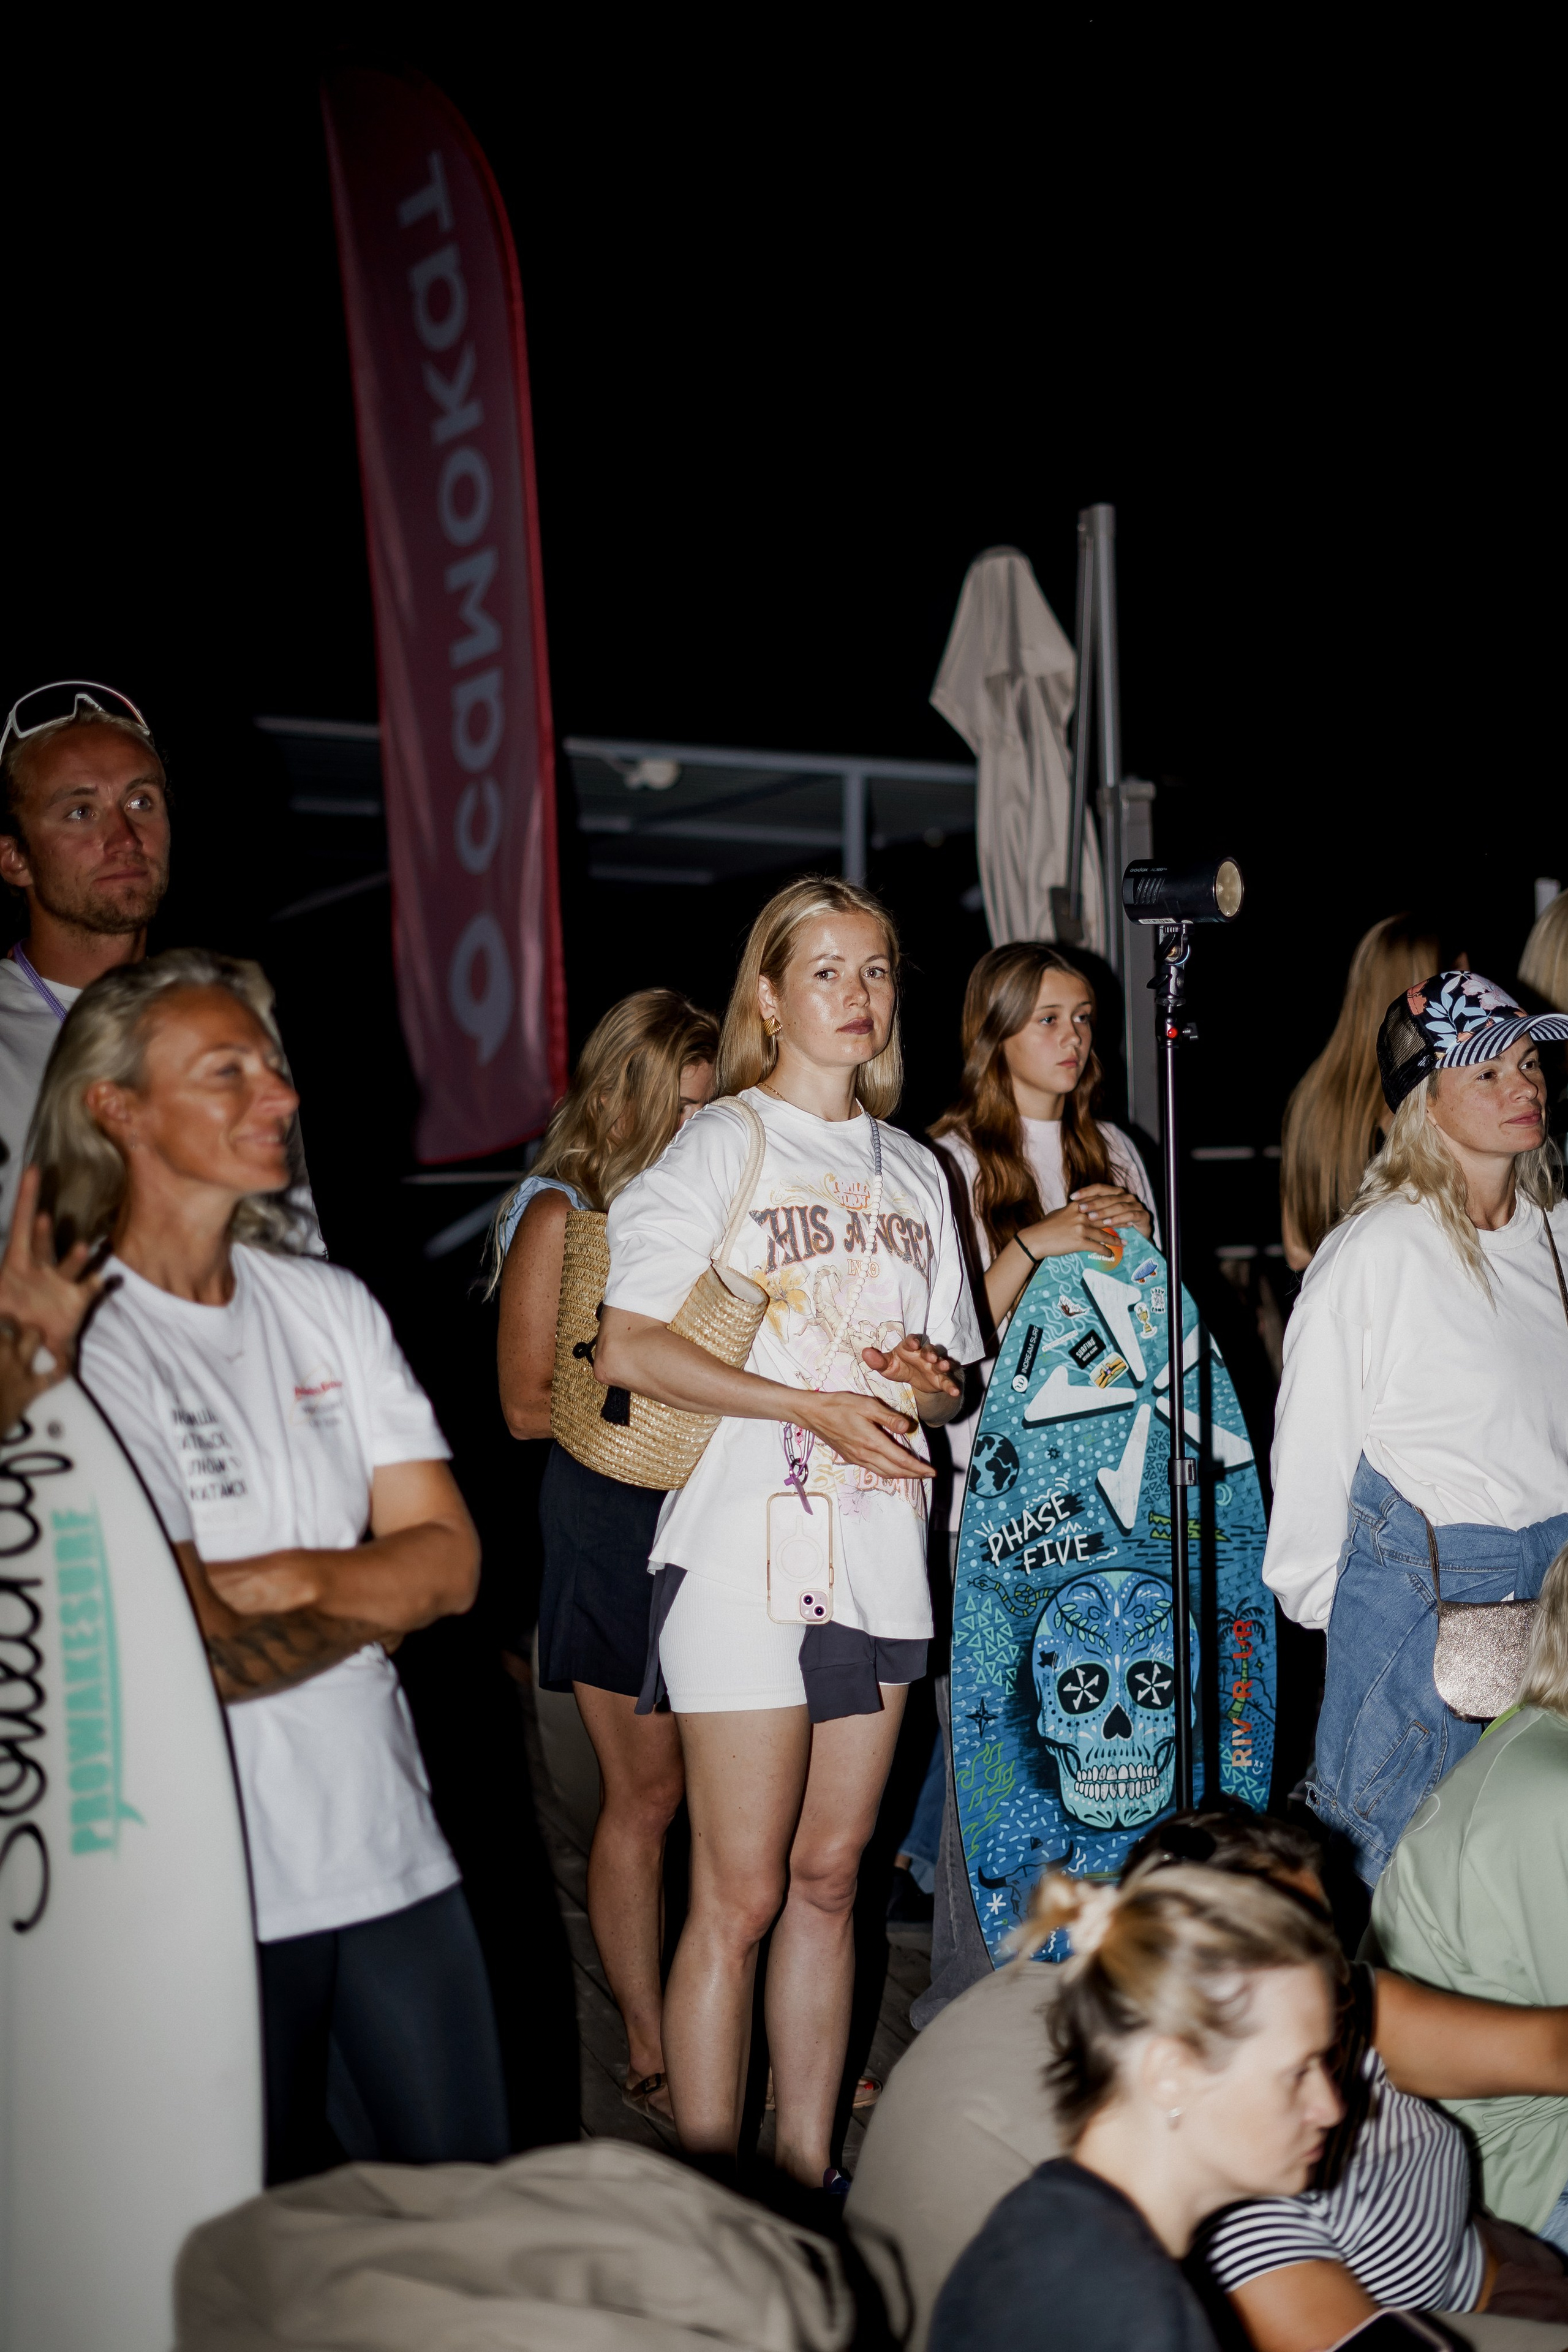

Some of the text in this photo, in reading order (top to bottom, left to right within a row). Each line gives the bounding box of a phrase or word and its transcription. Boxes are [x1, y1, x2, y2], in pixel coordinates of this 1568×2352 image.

[846, 1259, 880, 1278] INO
[1021, 1325, 1039, 1373] INDREAM SURF
[1076, 1336, 1096, 1359] SURFING
[988, 1490, 1070, 1567] PHASE
[1023, 1533, 1090, 1575] FIVE
[51, 1508, 115, 1856] PROWAKESURF
